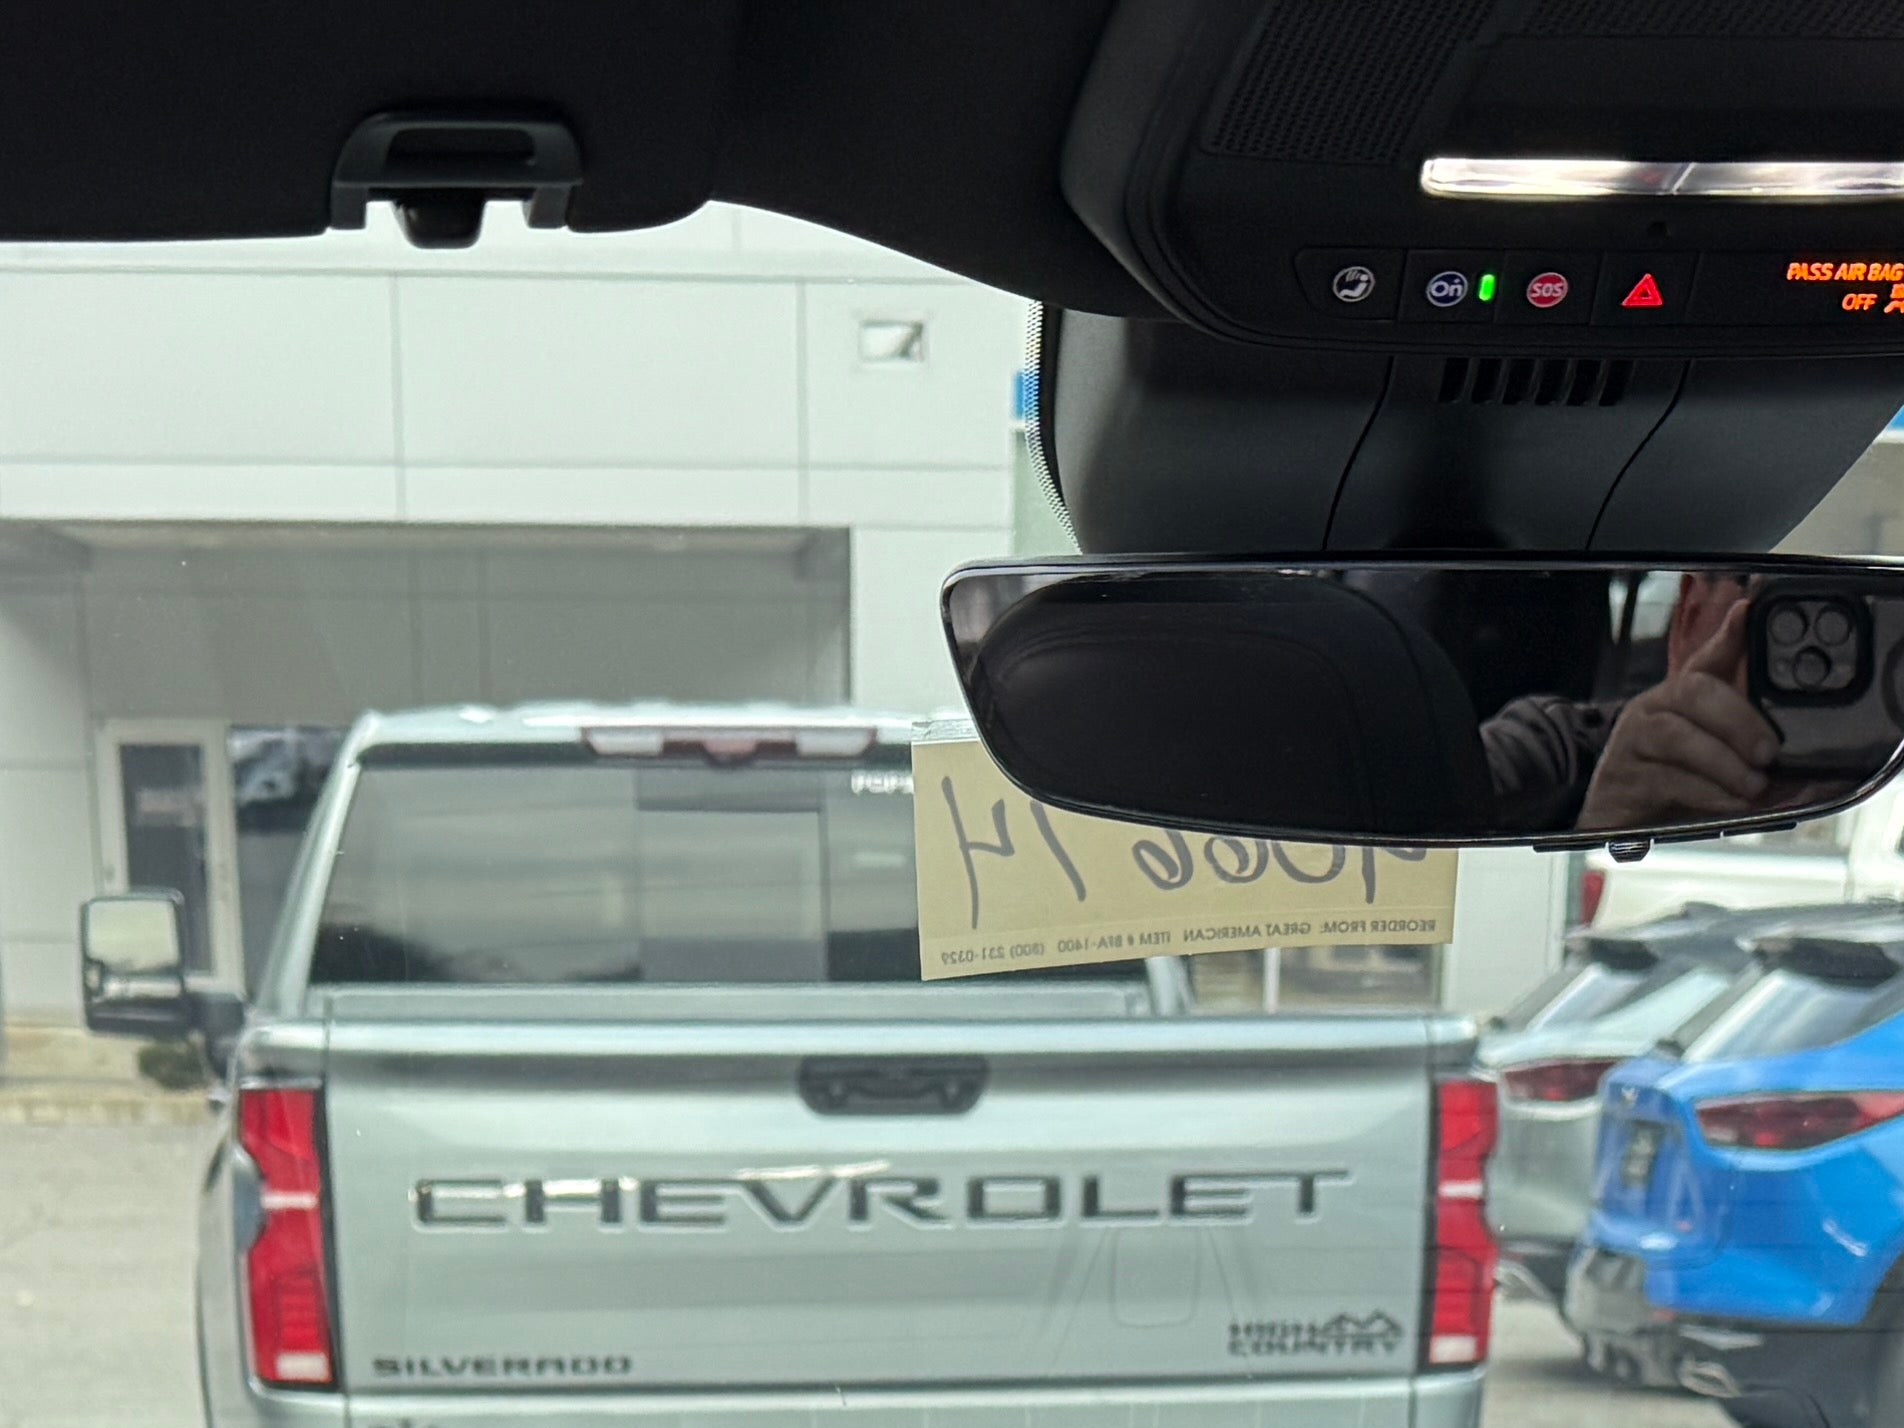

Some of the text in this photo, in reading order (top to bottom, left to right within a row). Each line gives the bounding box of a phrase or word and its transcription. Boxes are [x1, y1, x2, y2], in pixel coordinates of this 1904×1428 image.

[1787, 262, 1834, 281] PASS
[1531, 282, 1564, 297] SOS
[1842, 293, 1878, 310] OFF
[412, 1169, 1354, 1232] CHEVROLET
[373, 1355, 633, 1377] SILVERADO
